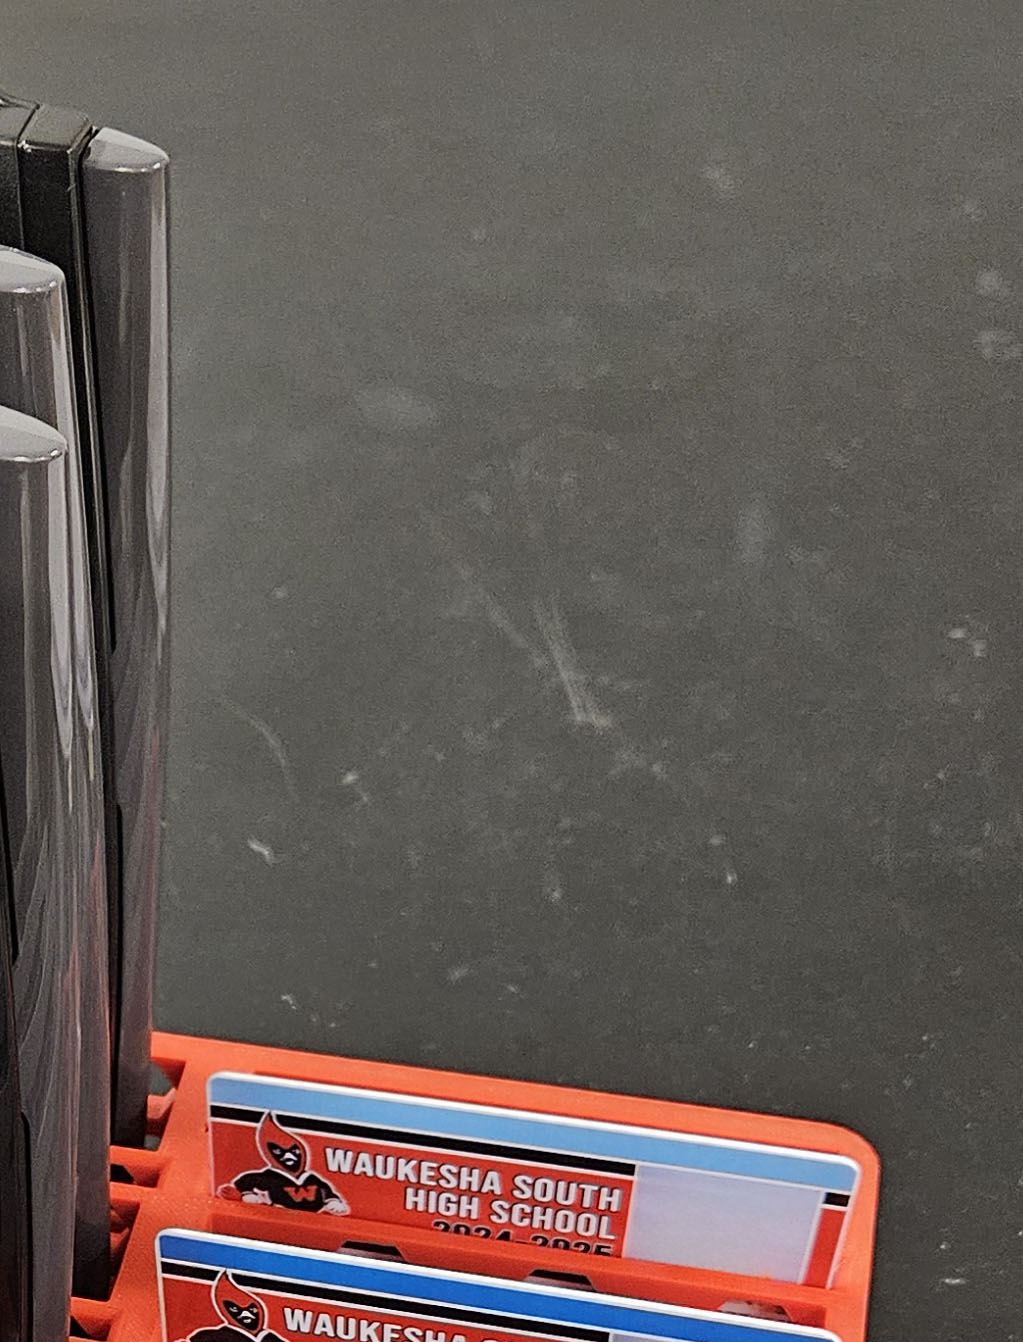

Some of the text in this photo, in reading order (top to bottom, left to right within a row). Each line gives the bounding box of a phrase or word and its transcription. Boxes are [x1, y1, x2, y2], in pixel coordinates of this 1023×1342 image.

[283, 1185, 317, 1202] W
[324, 1146, 622, 1212] WAUKESHA SOUTH
[405, 1187, 616, 1240] HIGH SCHOOL
